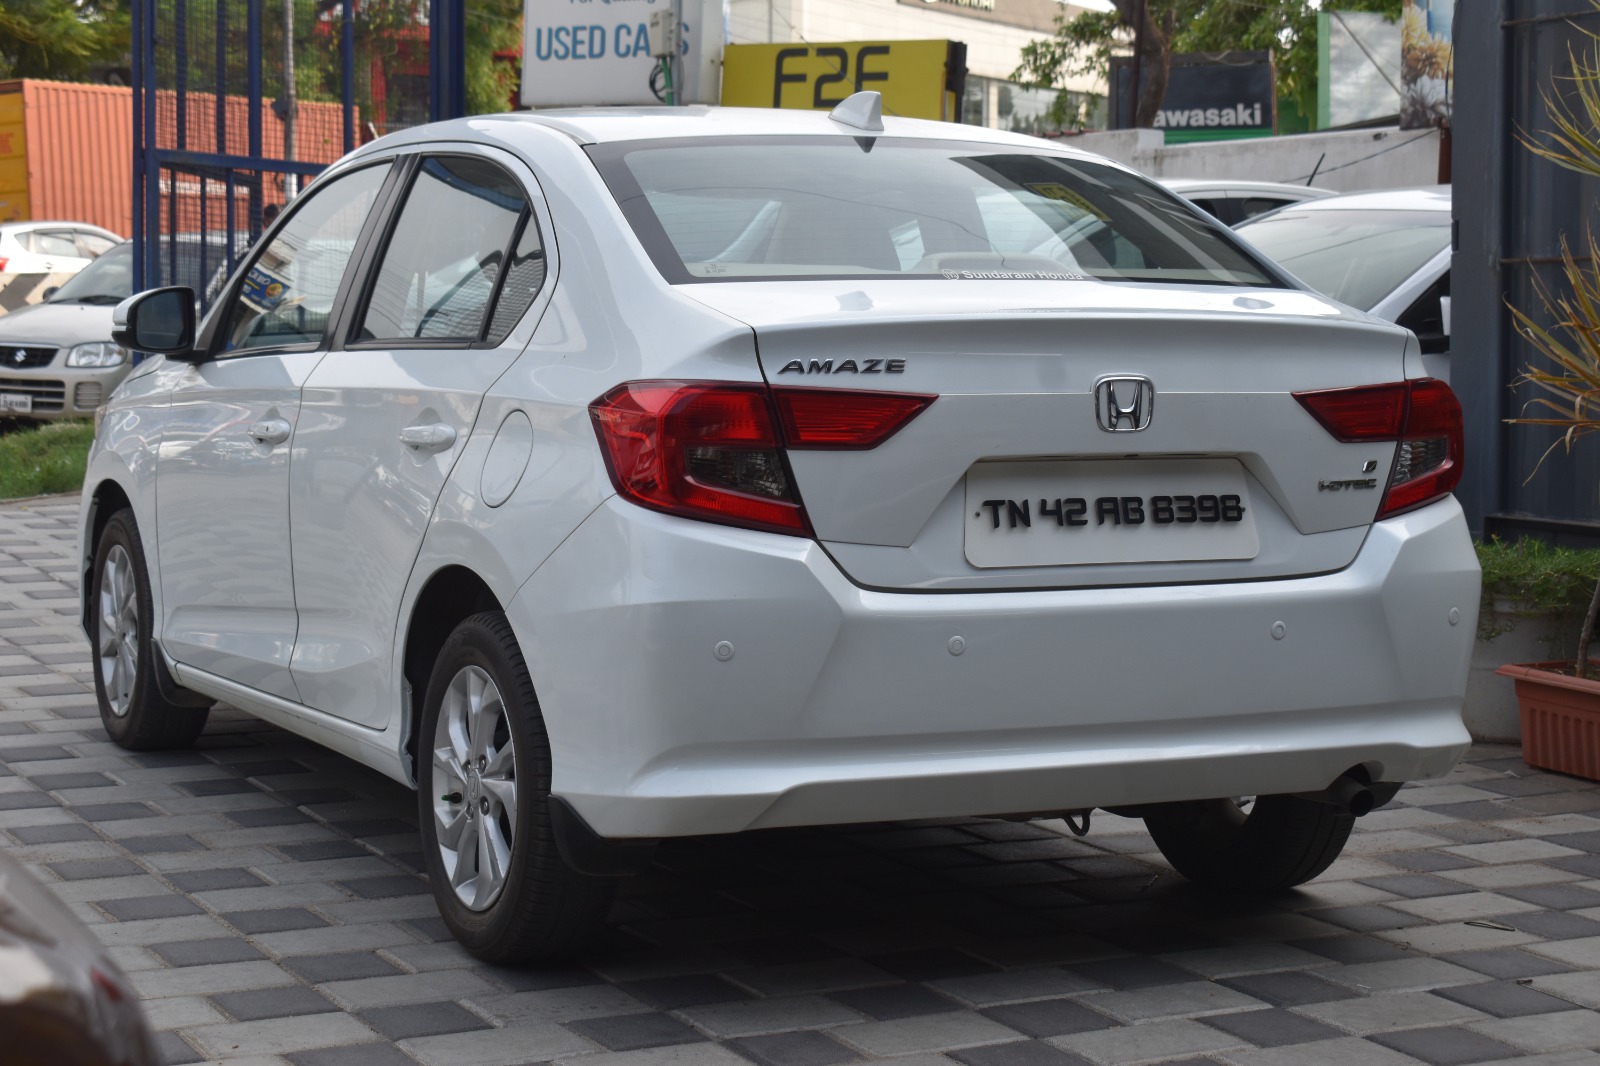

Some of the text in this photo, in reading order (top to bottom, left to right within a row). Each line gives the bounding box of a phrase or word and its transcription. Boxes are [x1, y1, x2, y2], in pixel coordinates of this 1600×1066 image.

[535, 25, 606, 61] USED
[773, 45, 890, 108] F2F
[1153, 102, 1262, 127] awasaki
[961, 269, 1035, 280] Sundaram
[1036, 270, 1084, 281] Honda
[777, 358, 907, 375] AMAZE
[982, 493, 1244, 529] TN 42 AB 8398
